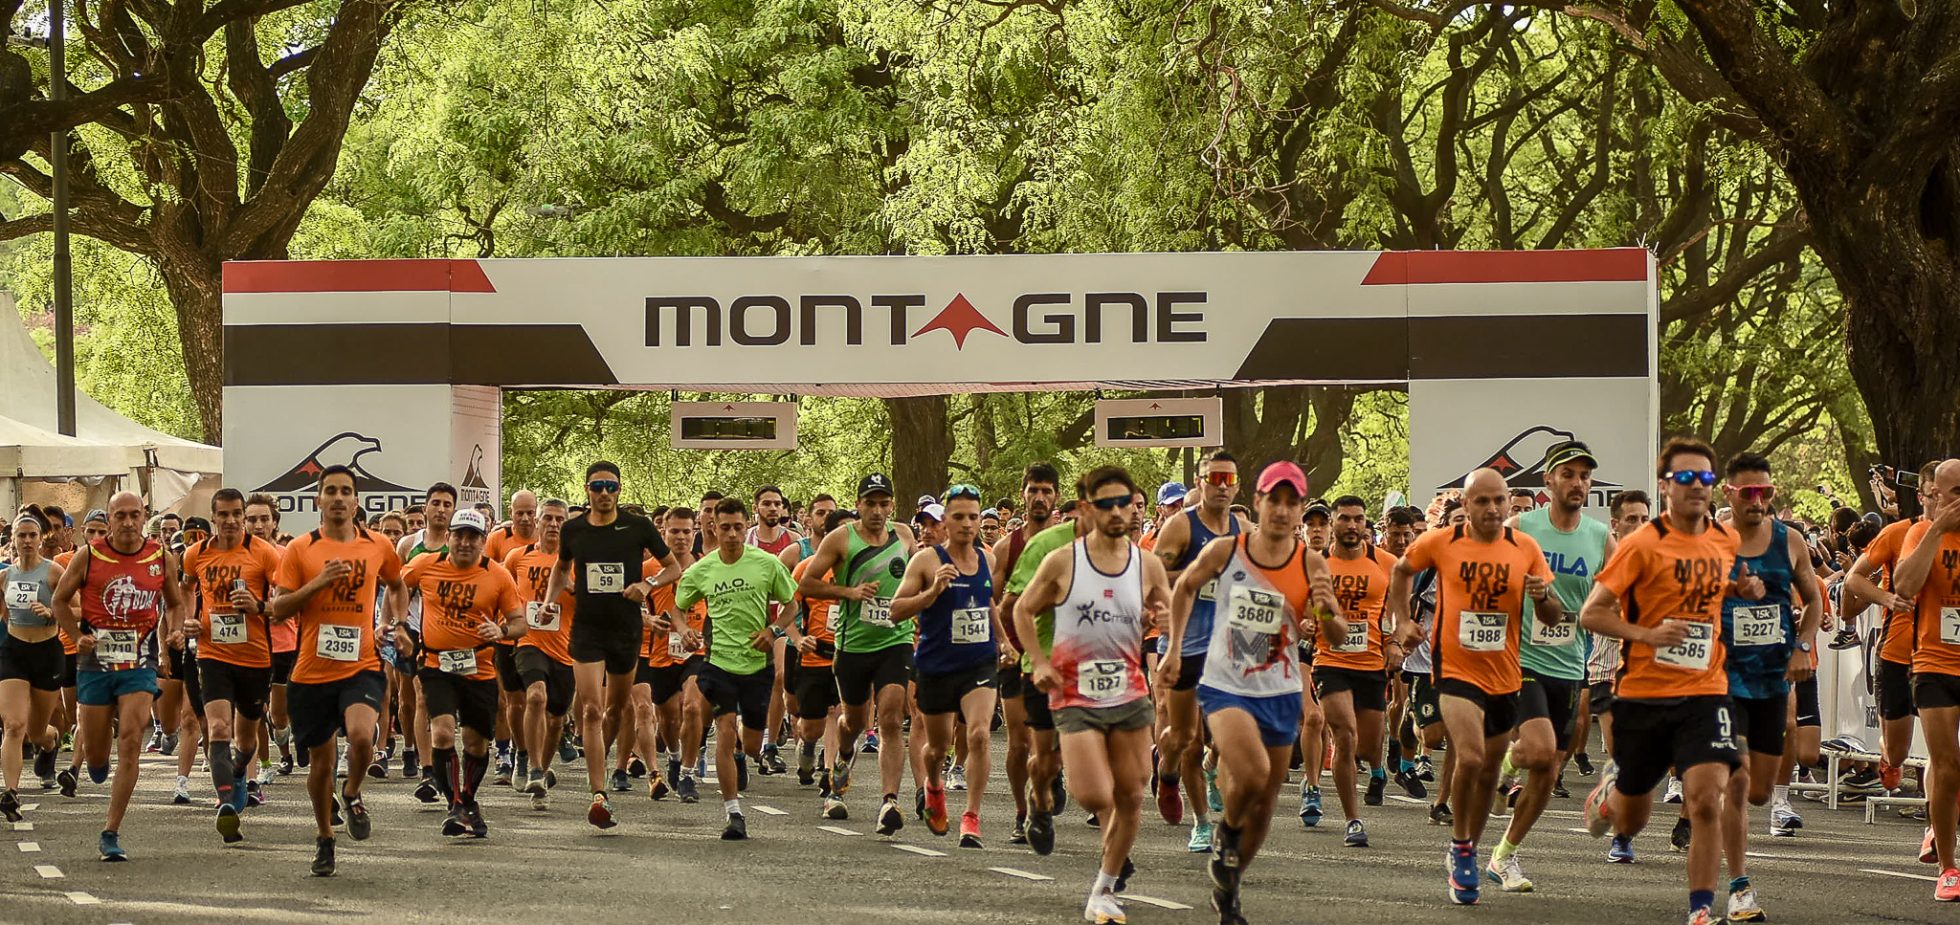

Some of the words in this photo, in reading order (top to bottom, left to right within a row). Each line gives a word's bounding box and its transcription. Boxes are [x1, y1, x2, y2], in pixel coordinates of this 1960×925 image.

[644, 291, 1208, 351] MONTAGNE
[206, 565, 241, 582] MON
[325, 560, 366, 577] ON
[528, 566, 551, 580] MO
[1460, 562, 1510, 581] MON
[1675, 558, 1722, 583] MON
[600, 576, 613, 586] 59
[714, 578, 748, 593] M.O.
[437, 581, 477, 597] MON
[17, 594, 28, 603] 22
[1470, 593, 1499, 610] NE
[1237, 606, 1274, 623] 3680
[1482, 616, 1497, 625] 15k
[1756, 610, 1770, 619] 15k
[220, 627, 238, 637] 474
[961, 624, 985, 635] 1544
[1469, 630, 1501, 642] 1988
[1540, 626, 1570, 637] 4535
[1743, 623, 1774, 637] 5227
[105, 643, 131, 653] 1710
[326, 640, 354, 653] 2395
[1718, 708, 1731, 736] 9
